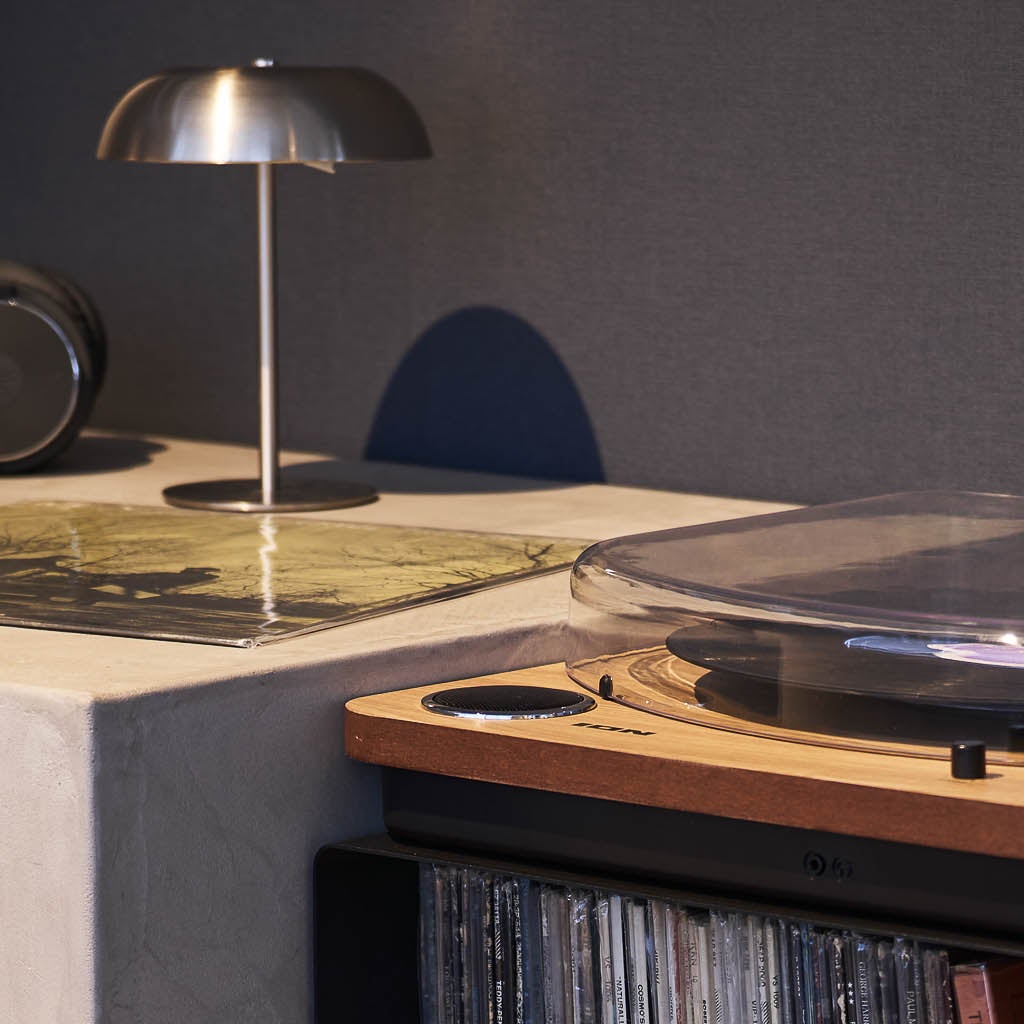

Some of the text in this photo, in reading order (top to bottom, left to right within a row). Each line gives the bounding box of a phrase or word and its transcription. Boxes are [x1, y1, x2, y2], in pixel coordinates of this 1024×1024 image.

[571, 722, 657, 736] ION
[496, 980, 504, 1009] TEDDY
[859, 961, 869, 999] GEORGE
[637, 984, 646, 1024] COSMO'S
[906, 991, 916, 1016] PAUL
